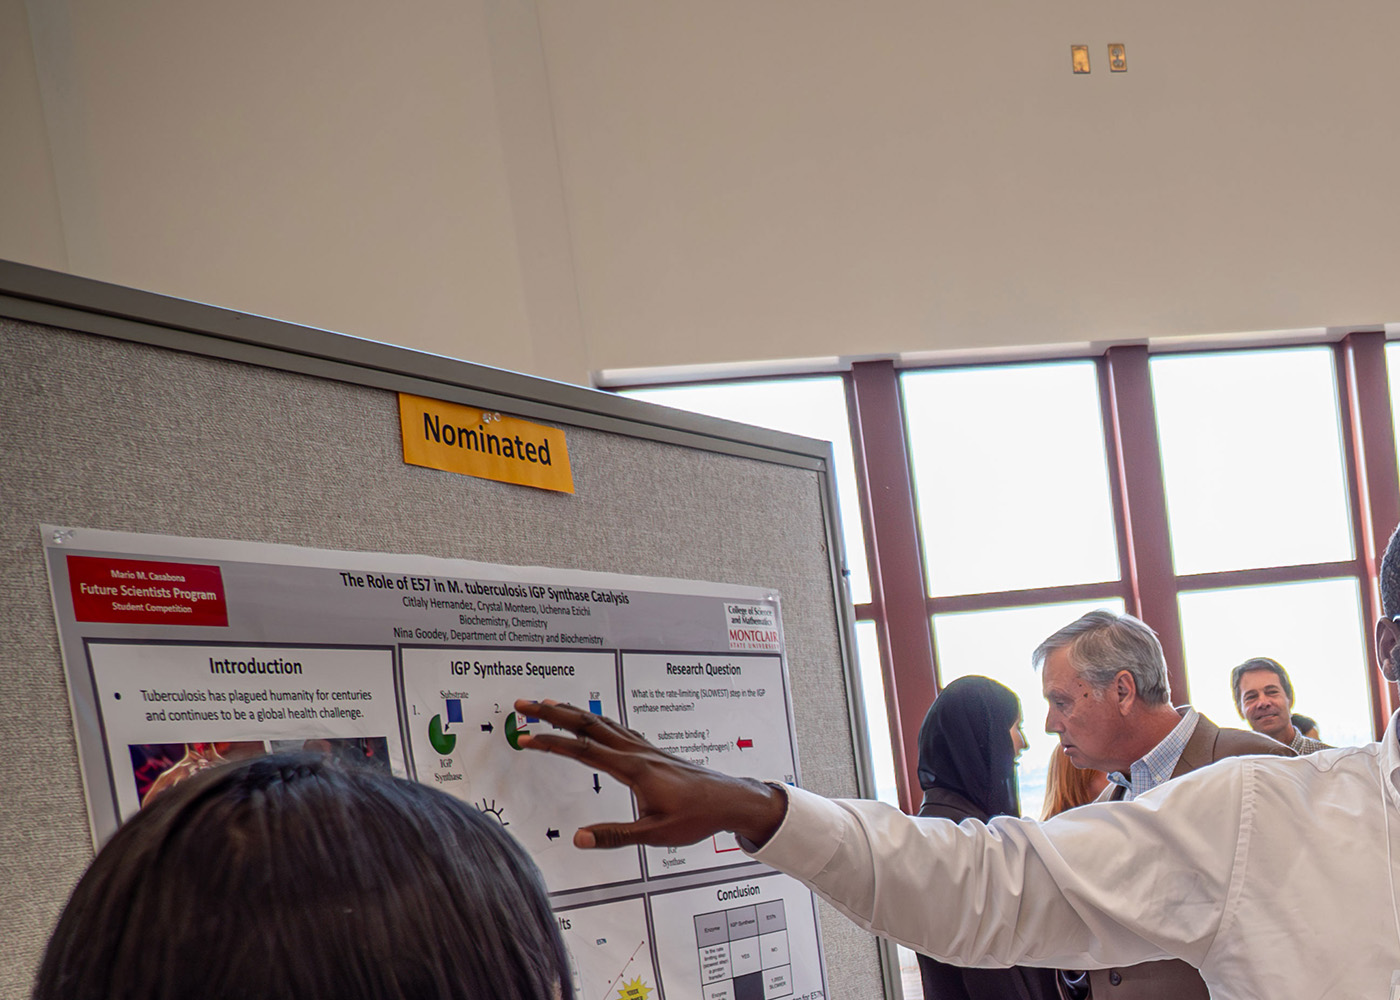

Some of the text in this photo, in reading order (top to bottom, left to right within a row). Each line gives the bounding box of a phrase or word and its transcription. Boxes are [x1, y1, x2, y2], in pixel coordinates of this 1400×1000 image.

[423, 412, 552, 466] Nominated
[110, 570, 185, 582] Mario M. Casabona
[80, 583, 216, 602] Future Scientists Program
[340, 572, 630, 606] The Role of E57 in M. tuberculosis IGP Synthase Catalysis
[112, 602, 192, 613] Student Competition
[402, 597, 590, 616] Citlaly Hernandez, Crystal Montero, Uchenna Ezichi
[459, 615, 548, 630] Biochemistry, Chemistry
[394, 627, 604, 646] Nina Goodey, Department of Chemistry and Biochemistry
[730, 629, 779, 642] MONTCLAIR
[209, 657, 302, 675] Introduction
[451, 661, 575, 678] IGP Synthase Sequence
[667, 663, 741, 676] Research Question
[139, 689, 372, 704] Tuberculosis has plagued humanity for centuries
[440, 690, 469, 699] Substrate
[631, 688, 765, 699] What is the rate-limiting (SLOWEST) step the IGP
[145, 707, 364, 722] and continues to be a global health challenge.
[412, 705, 420, 715] 1.
[494, 704, 502, 713] 2.
[633, 702, 695, 714] synthase mechanism?
[658, 731, 684, 740] substrate
[685, 730, 706, 740] binding
[440, 759, 453, 768] IGP
[435, 773, 462, 783] Synthase
[717, 885, 760, 901] Conclusion
